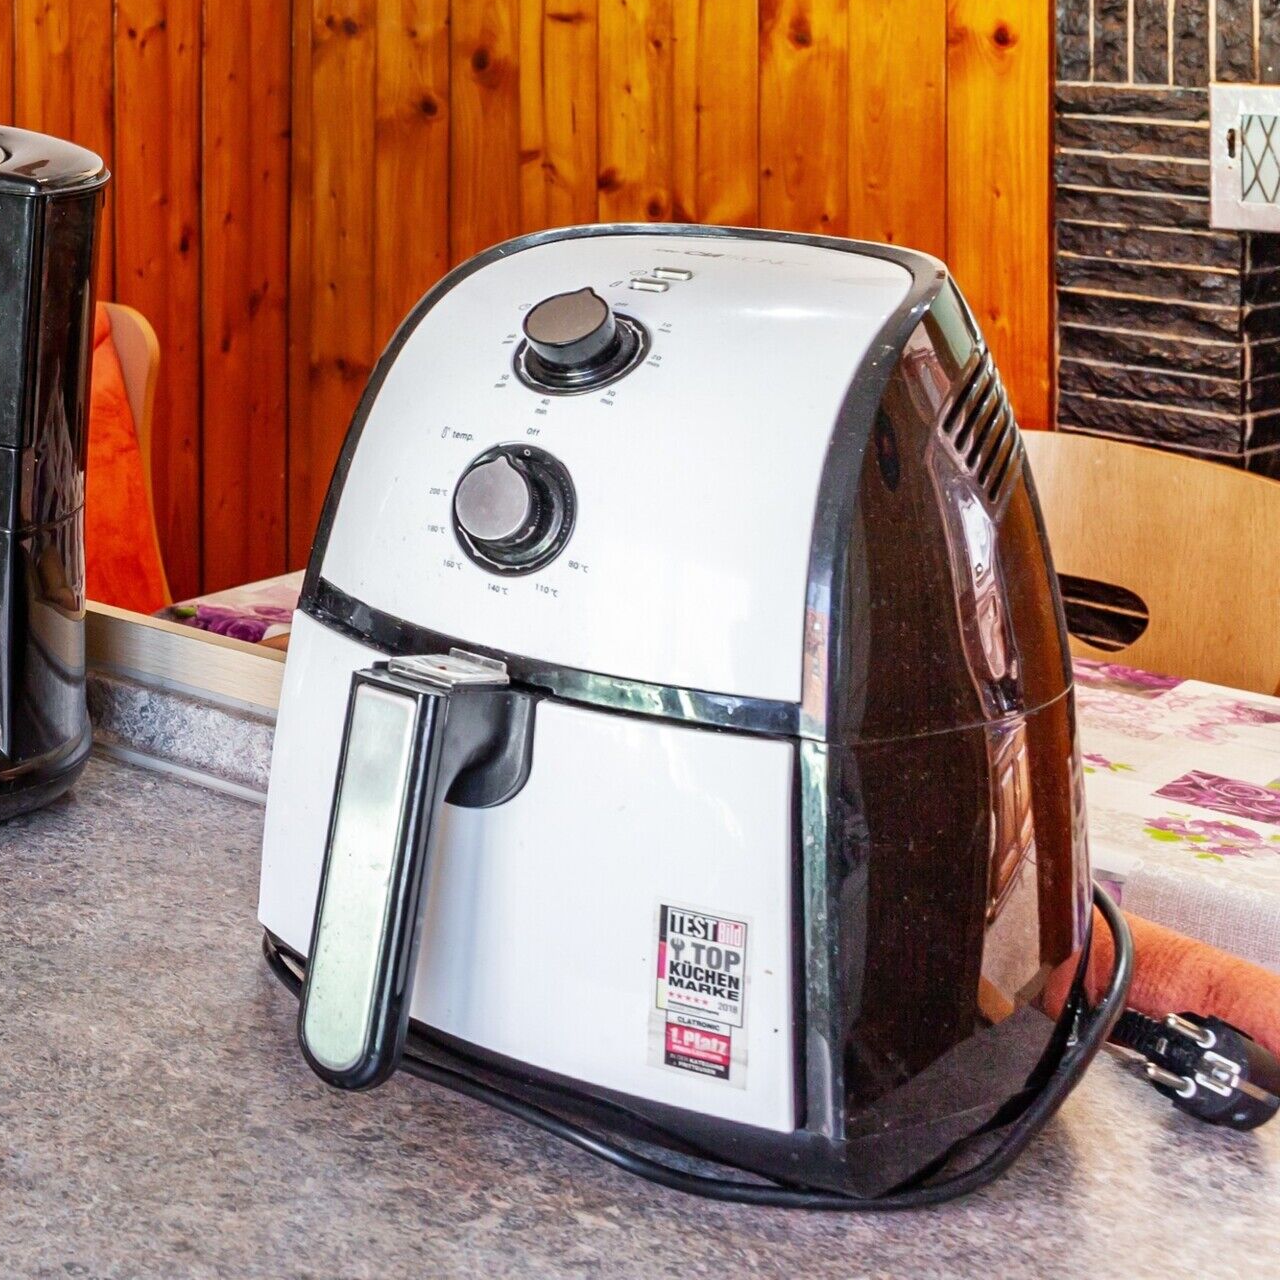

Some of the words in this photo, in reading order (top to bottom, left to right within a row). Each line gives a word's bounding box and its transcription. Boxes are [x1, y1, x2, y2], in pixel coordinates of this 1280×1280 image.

[670, 911, 718, 942] TEST
[690, 942, 741, 973] TOP
[668, 976, 740, 1002] MARKE
[669, 960, 740, 990] KÜCHEN
[677, 1016, 720, 1031] CLATRONIC
[670, 1027, 683, 1045] 1.
[683, 1029, 728, 1056] Platz
